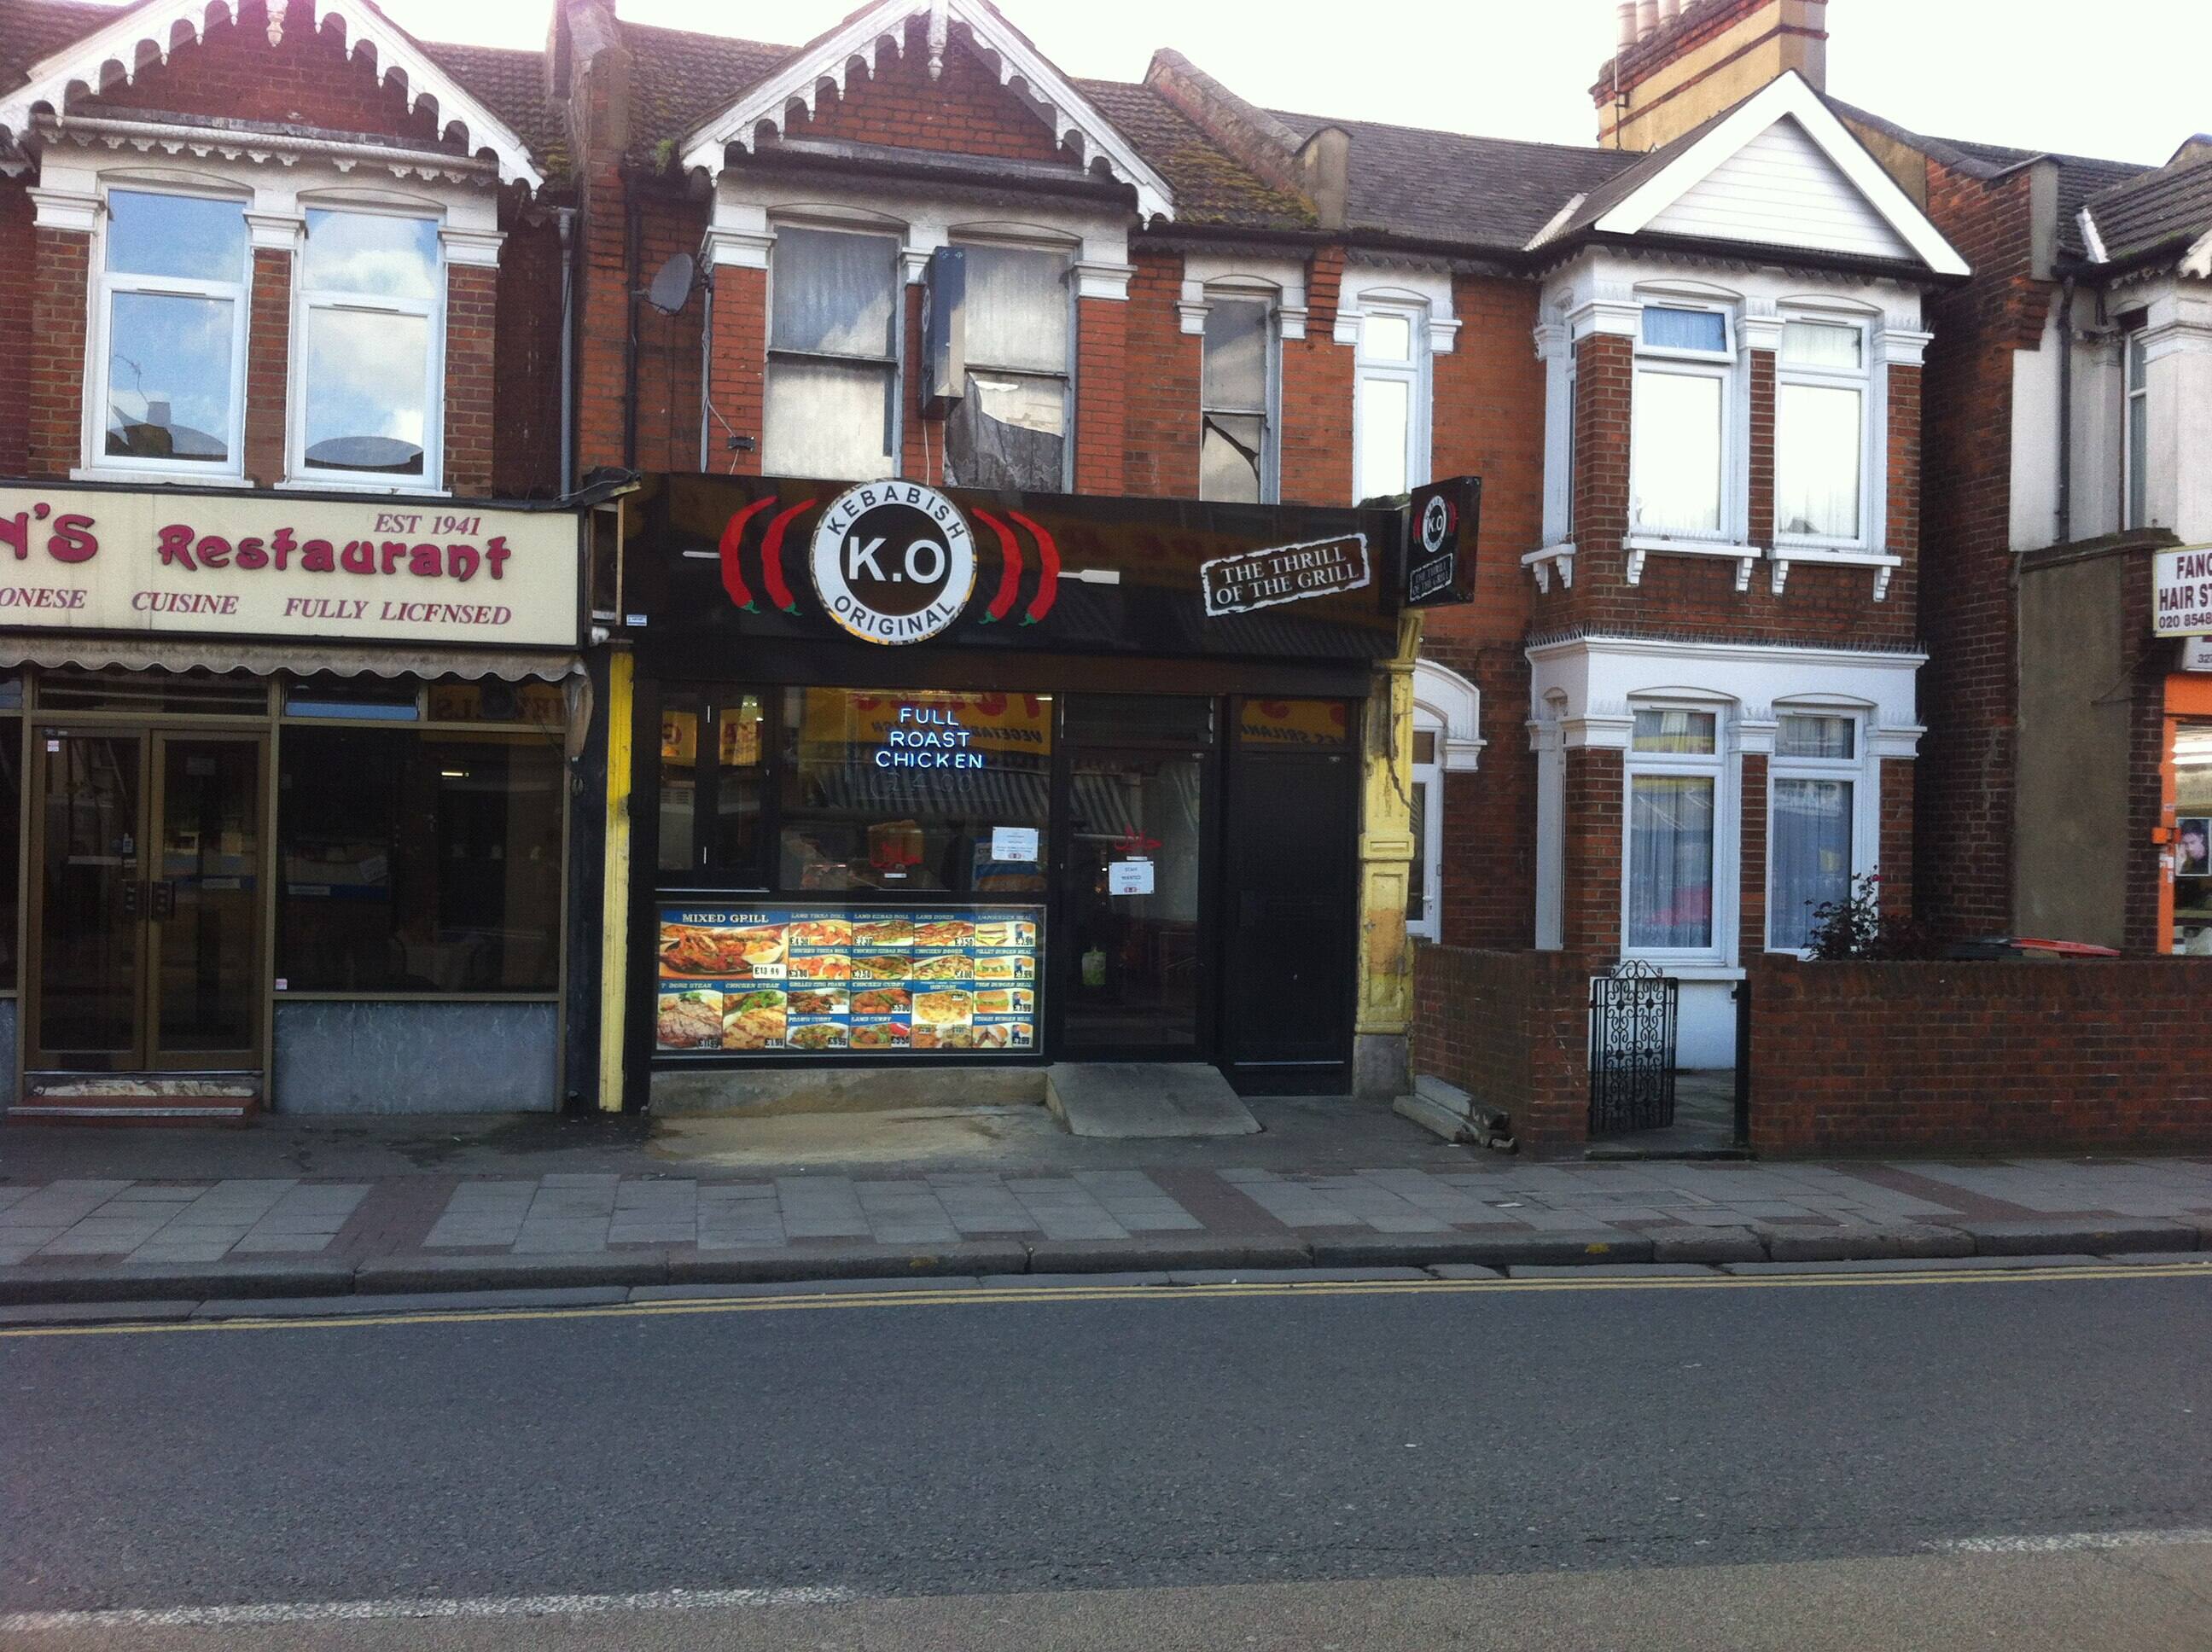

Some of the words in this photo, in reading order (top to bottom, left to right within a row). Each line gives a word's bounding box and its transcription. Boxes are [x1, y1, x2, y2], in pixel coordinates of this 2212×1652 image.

[374, 514, 422, 533] EST
[431, 515, 481, 536] 1941
[827, 486, 964, 539] KEBABISH
[158, 524, 511, 582] Restaurant
[848, 537, 946, 584] K.O
[1221, 561, 1265, 585] THE
[1269, 546, 1347, 575] THRILL
[1216, 585, 1243, 605] OF
[1249, 577, 1293, 598] THE
[1297, 563, 1359, 589] GRILL
[2159, 585, 2194, 611] HAIR
[0, 587, 87, 608] ONESE
[131, 591, 239, 615] CUISINE
[283, 597, 369, 620] FULLY
[835, 596, 955, 636] ORIGINAL
[2158, 615, 2180, 629] 020
[2183, 612, 2212, 627] 8548
[899, 707, 959, 726] FULL
[890, 730, 970, 747] ROAST
[876, 750, 982, 769] CHICKEN
[683, 914, 726, 922] MIXED
[730, 914, 769, 923] GRILL
